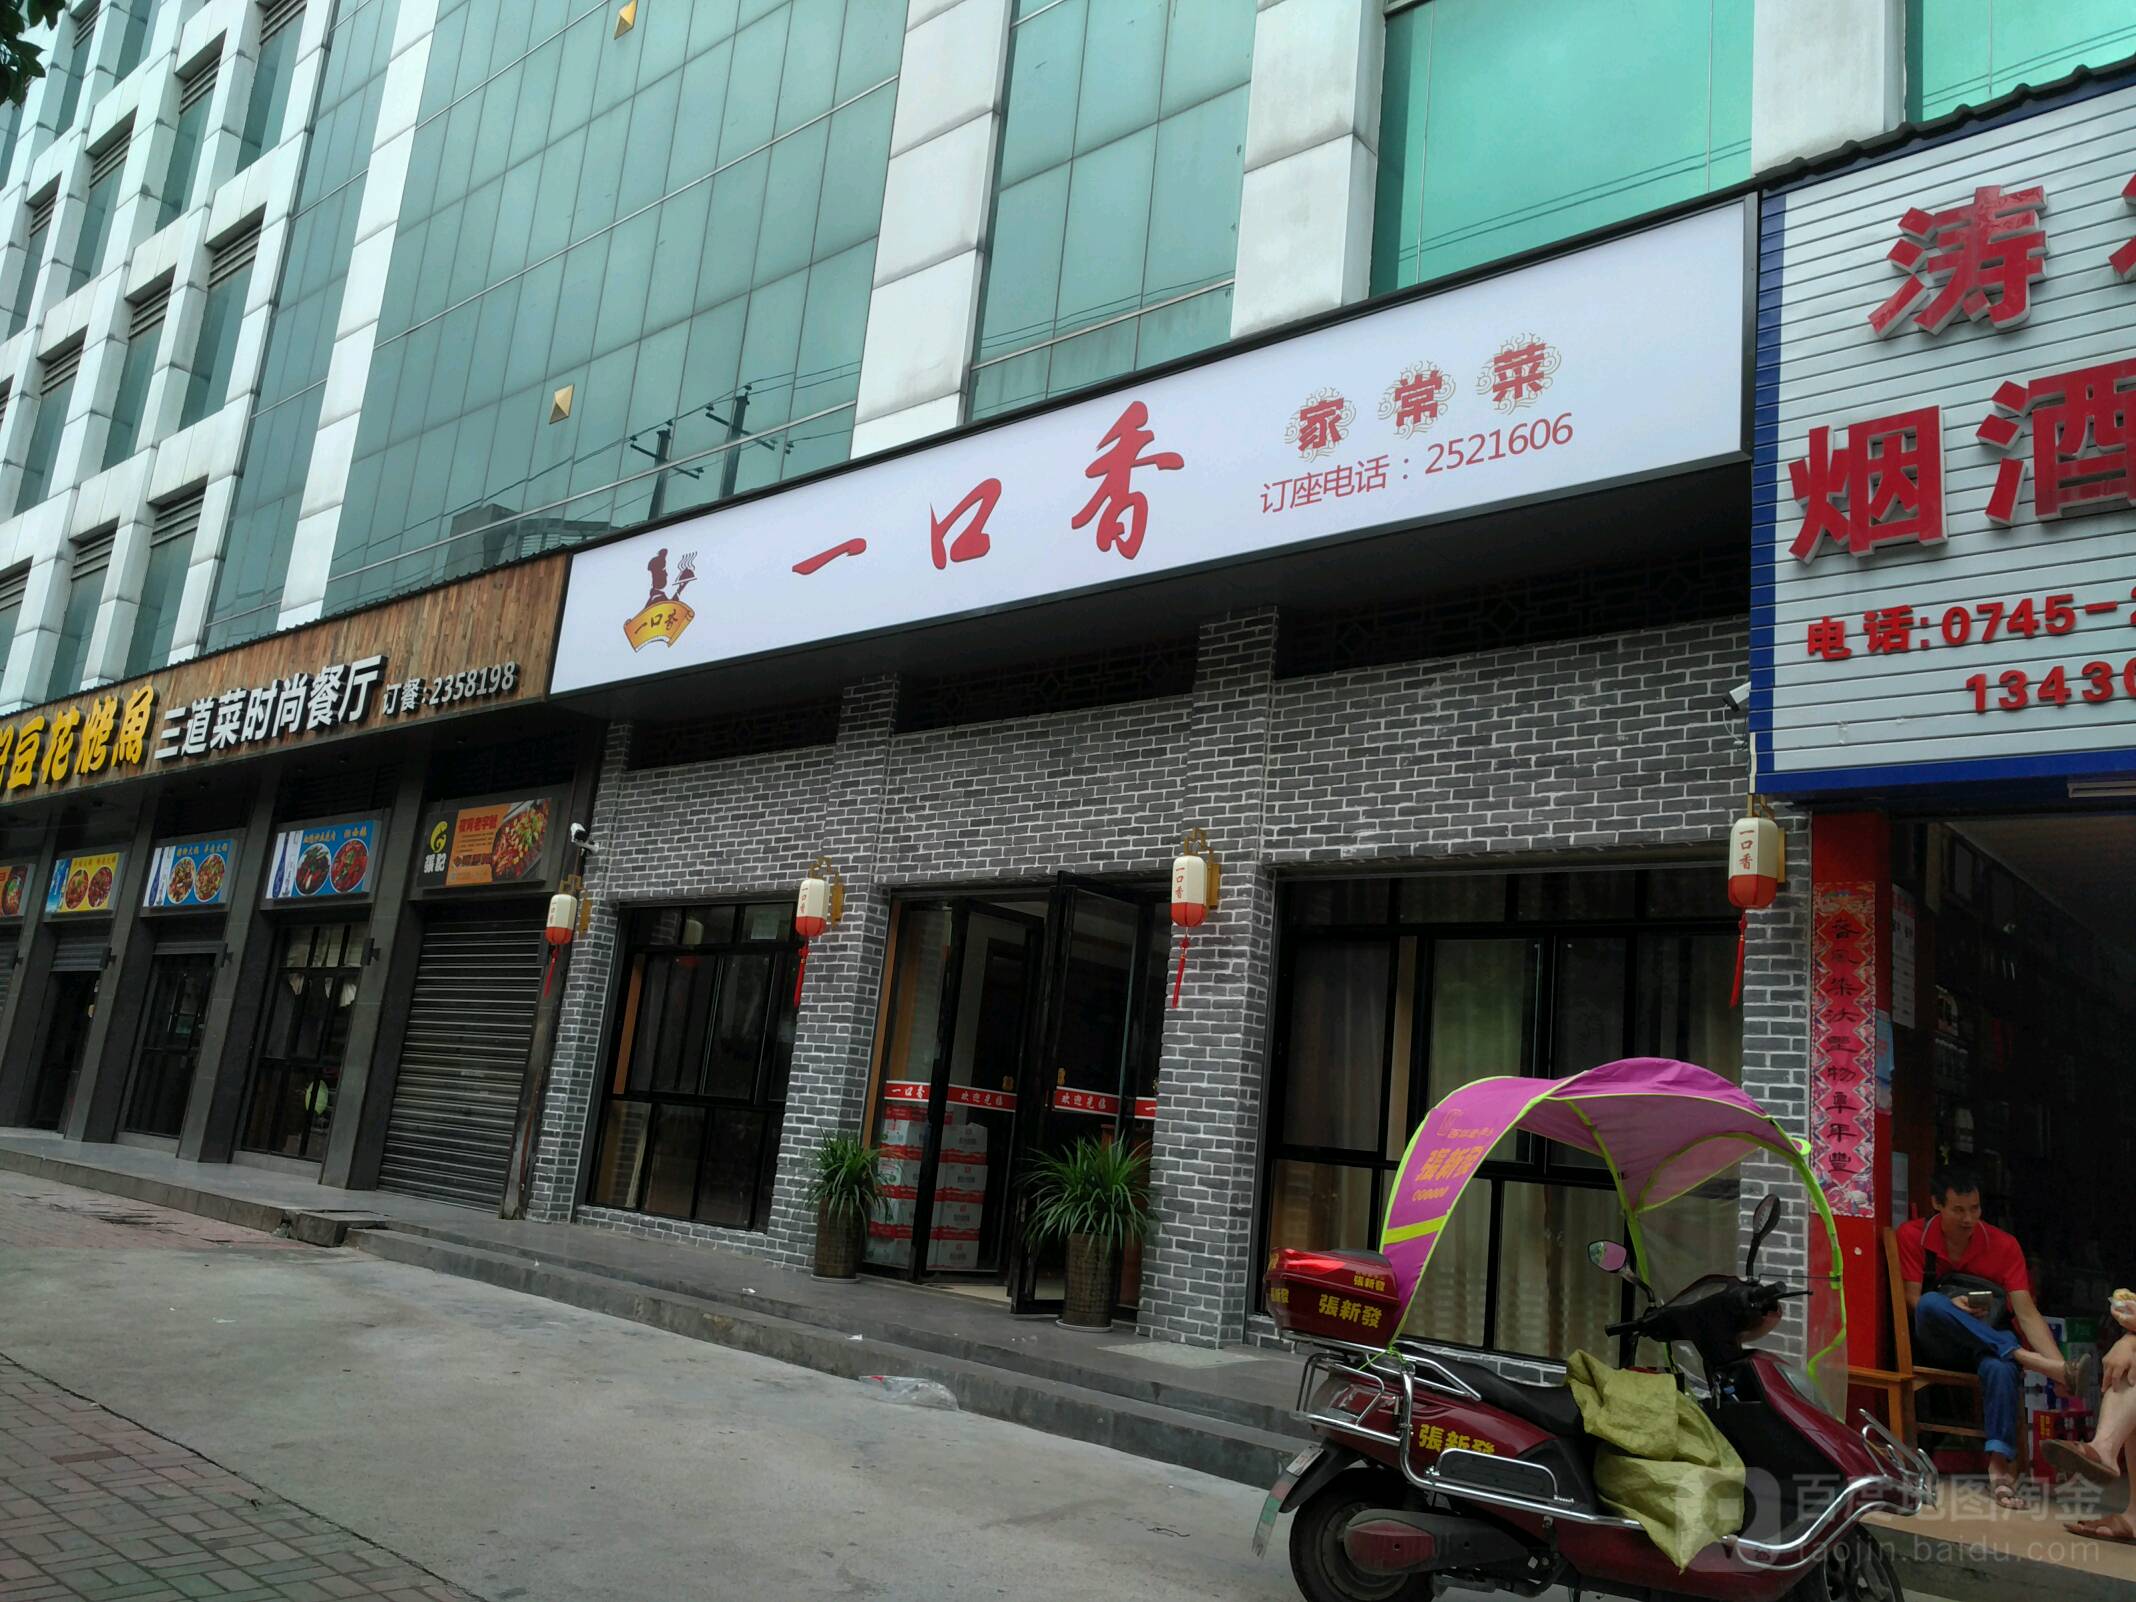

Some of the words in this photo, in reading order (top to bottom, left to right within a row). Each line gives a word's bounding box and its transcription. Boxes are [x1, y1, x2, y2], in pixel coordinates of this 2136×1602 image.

[1298, 342, 1547, 452] 家常菜
[793, 400, 1184, 570] 一口香
[1789, 357, 2136, 565] 烟酒
[634, 608, 679, 635] 一口香
[1807, 590, 2136, 661] 电话:0745-
[154, 655, 386, 760] 三道菜时尚餐厅
[383, 660, 519, 716] 订餐:2358198
[1739, 829, 1754, 870] 一口香
[1175, 867, 1185, 899] 一口香
[891, 1085, 925, 1100] 一口香
[1318, 1294, 1382, 1329] 張新發
